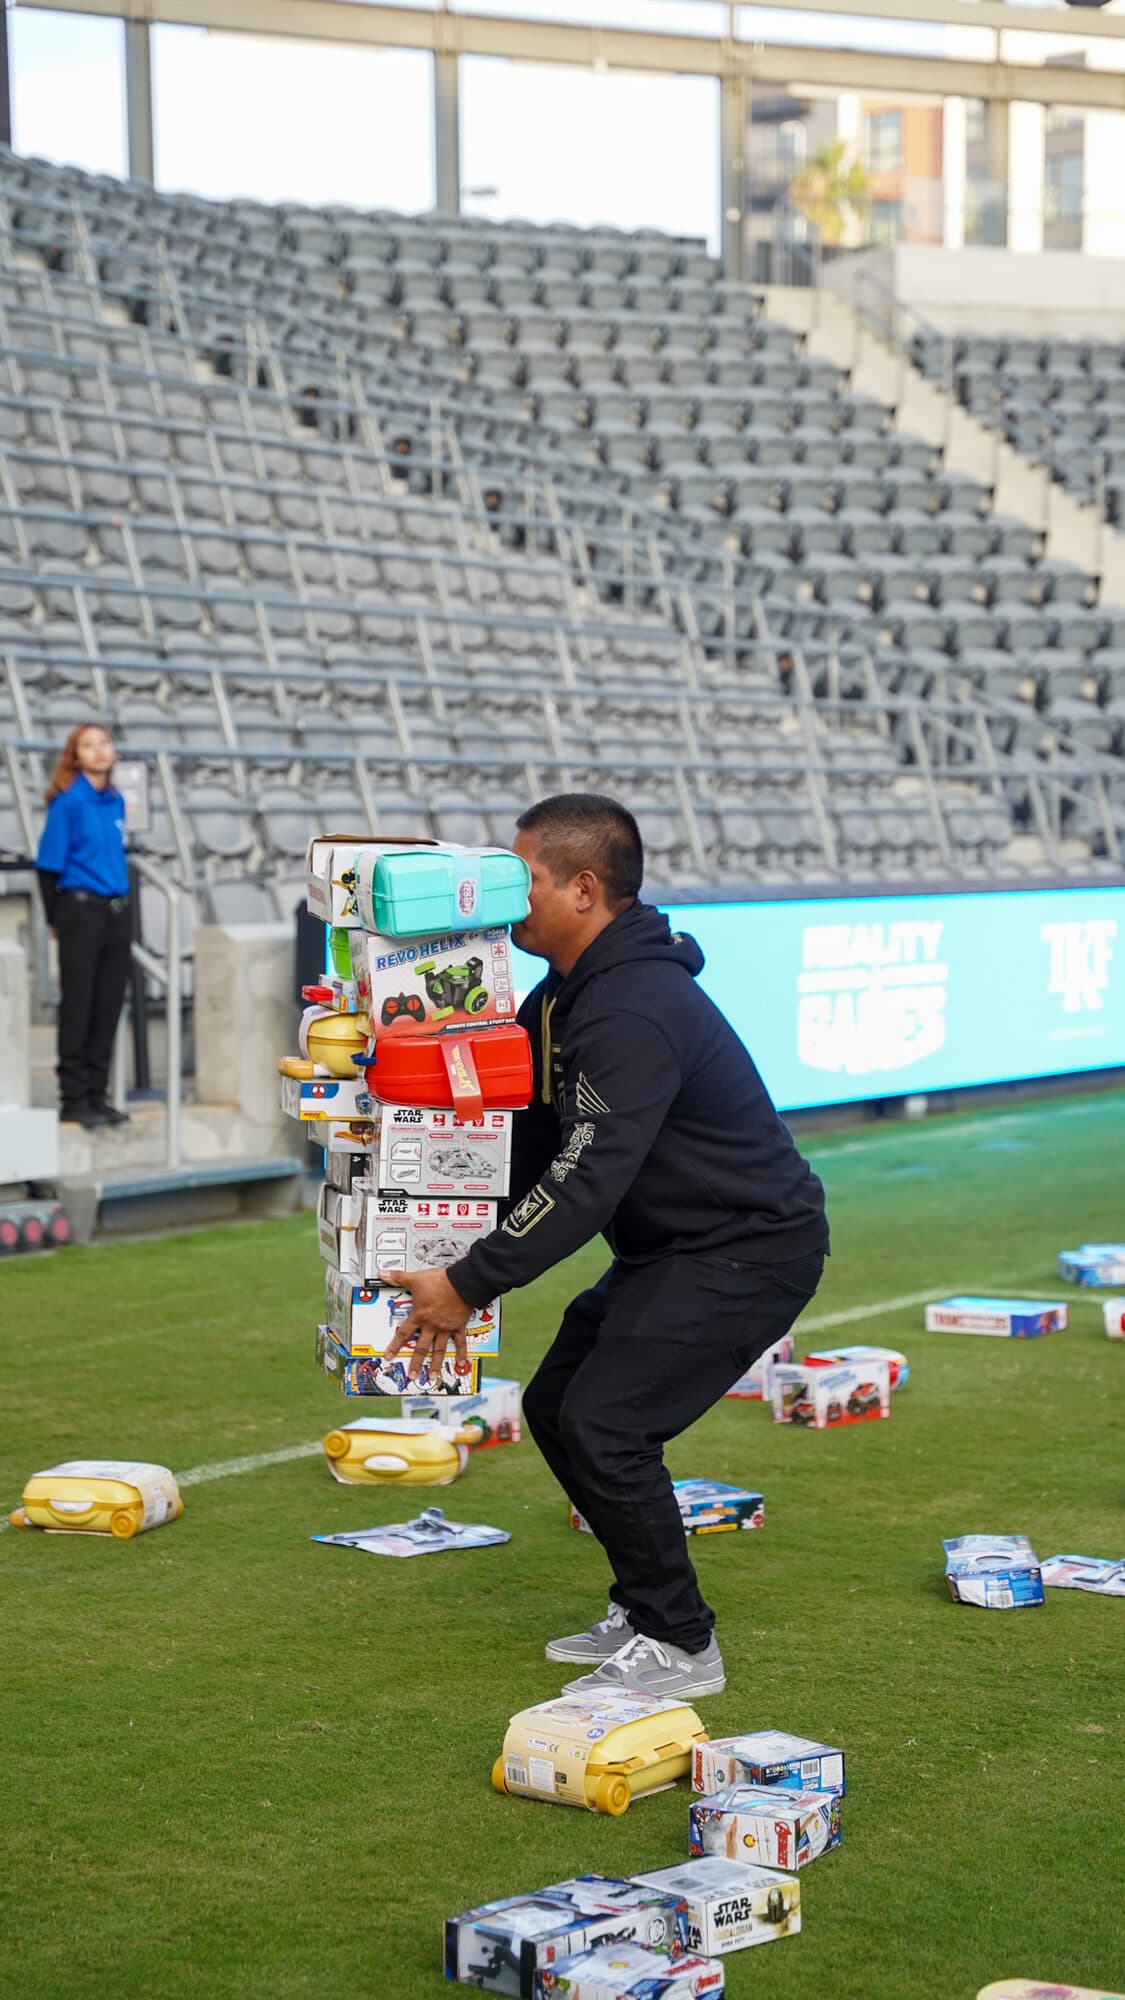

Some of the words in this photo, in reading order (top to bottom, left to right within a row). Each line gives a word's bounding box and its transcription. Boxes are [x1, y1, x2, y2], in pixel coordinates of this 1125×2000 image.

[376, 946, 417, 971] REVO
[419, 932, 466, 959] HELIX
[677, 1659, 693, 1673] VANS
[714, 1897, 752, 1917] STAR
[714, 1908, 752, 1928] WARS
